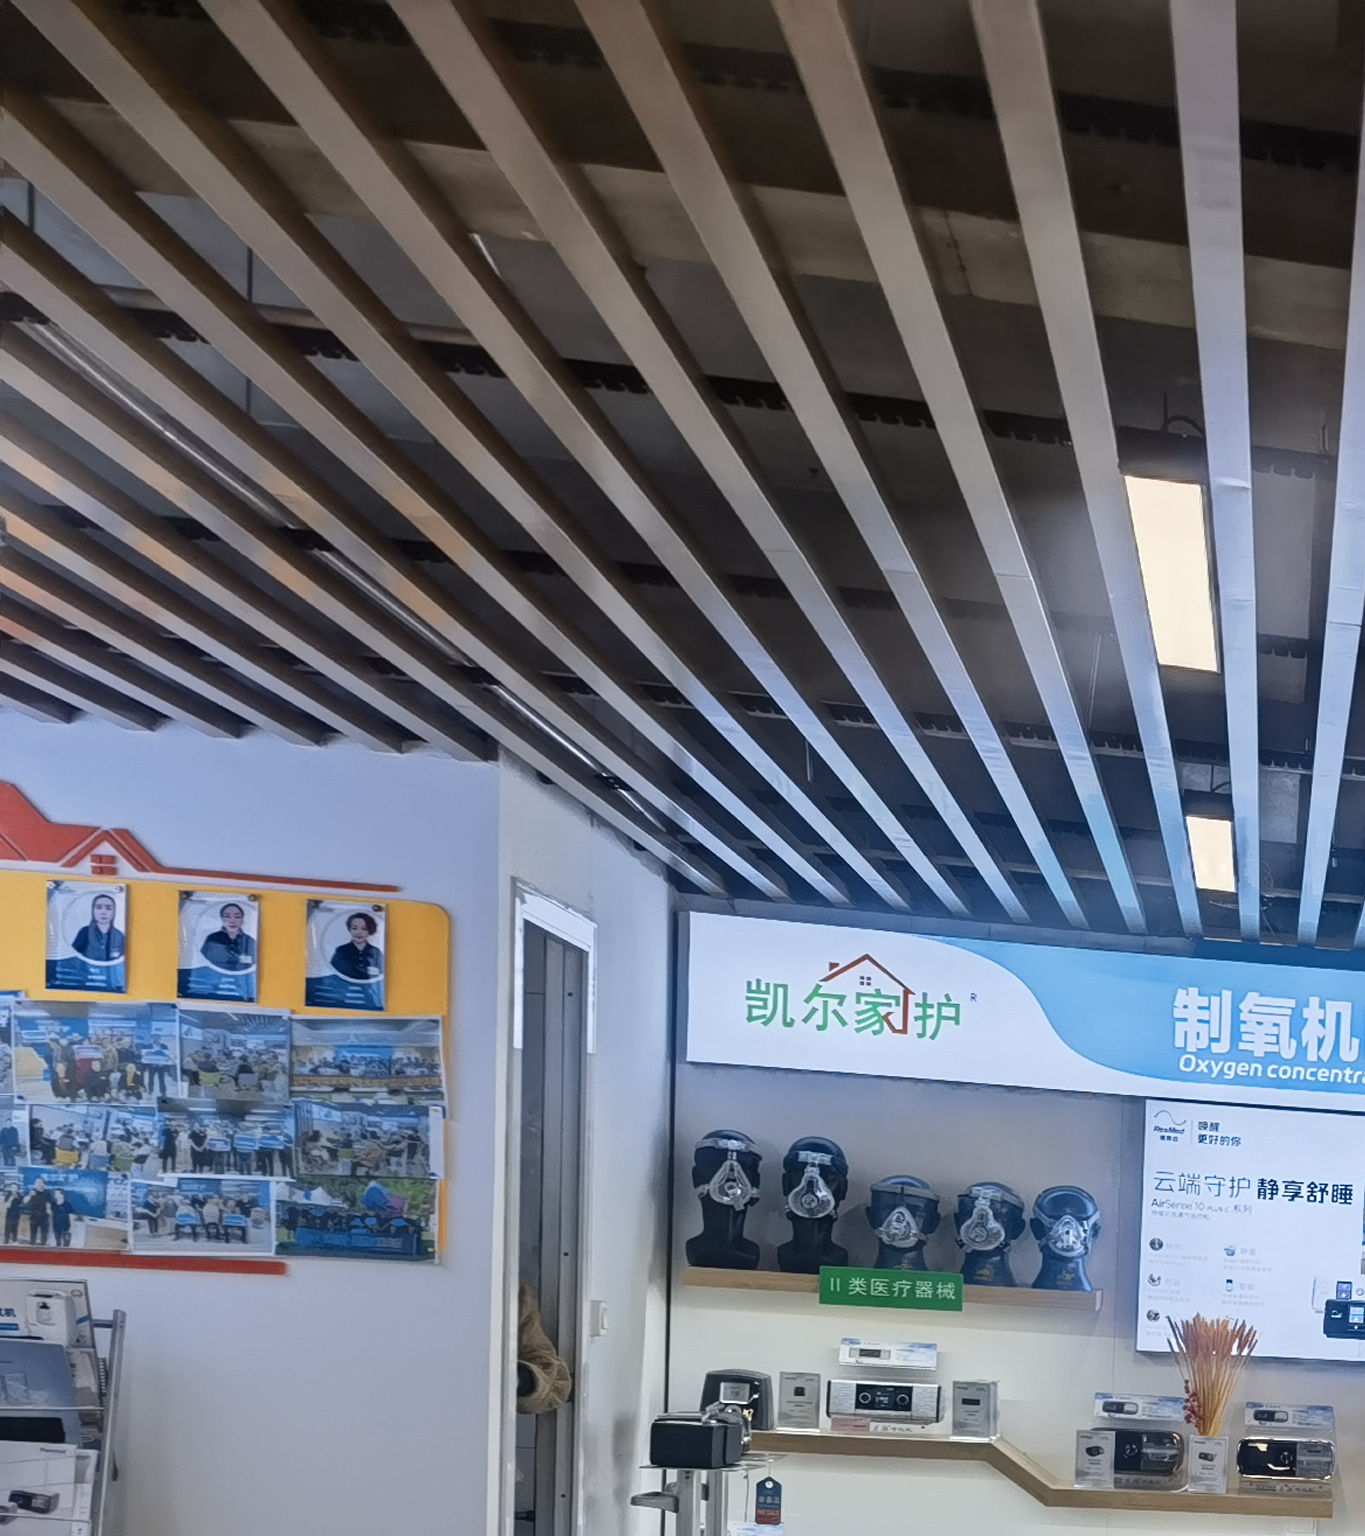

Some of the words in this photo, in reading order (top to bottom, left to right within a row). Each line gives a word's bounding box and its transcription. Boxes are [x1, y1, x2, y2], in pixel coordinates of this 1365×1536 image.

[745, 978, 961, 1041] 凯尔家护
[1179, 1054, 1263, 1080] Oxygen
[1197, 1133, 1242, 1147] 更好的你
[1153, 1170, 1251, 1199] 云端守护
[1257, 1177, 1354, 1205] 静享舒睡
[848, 1276, 957, 1301] 类医疗器械
